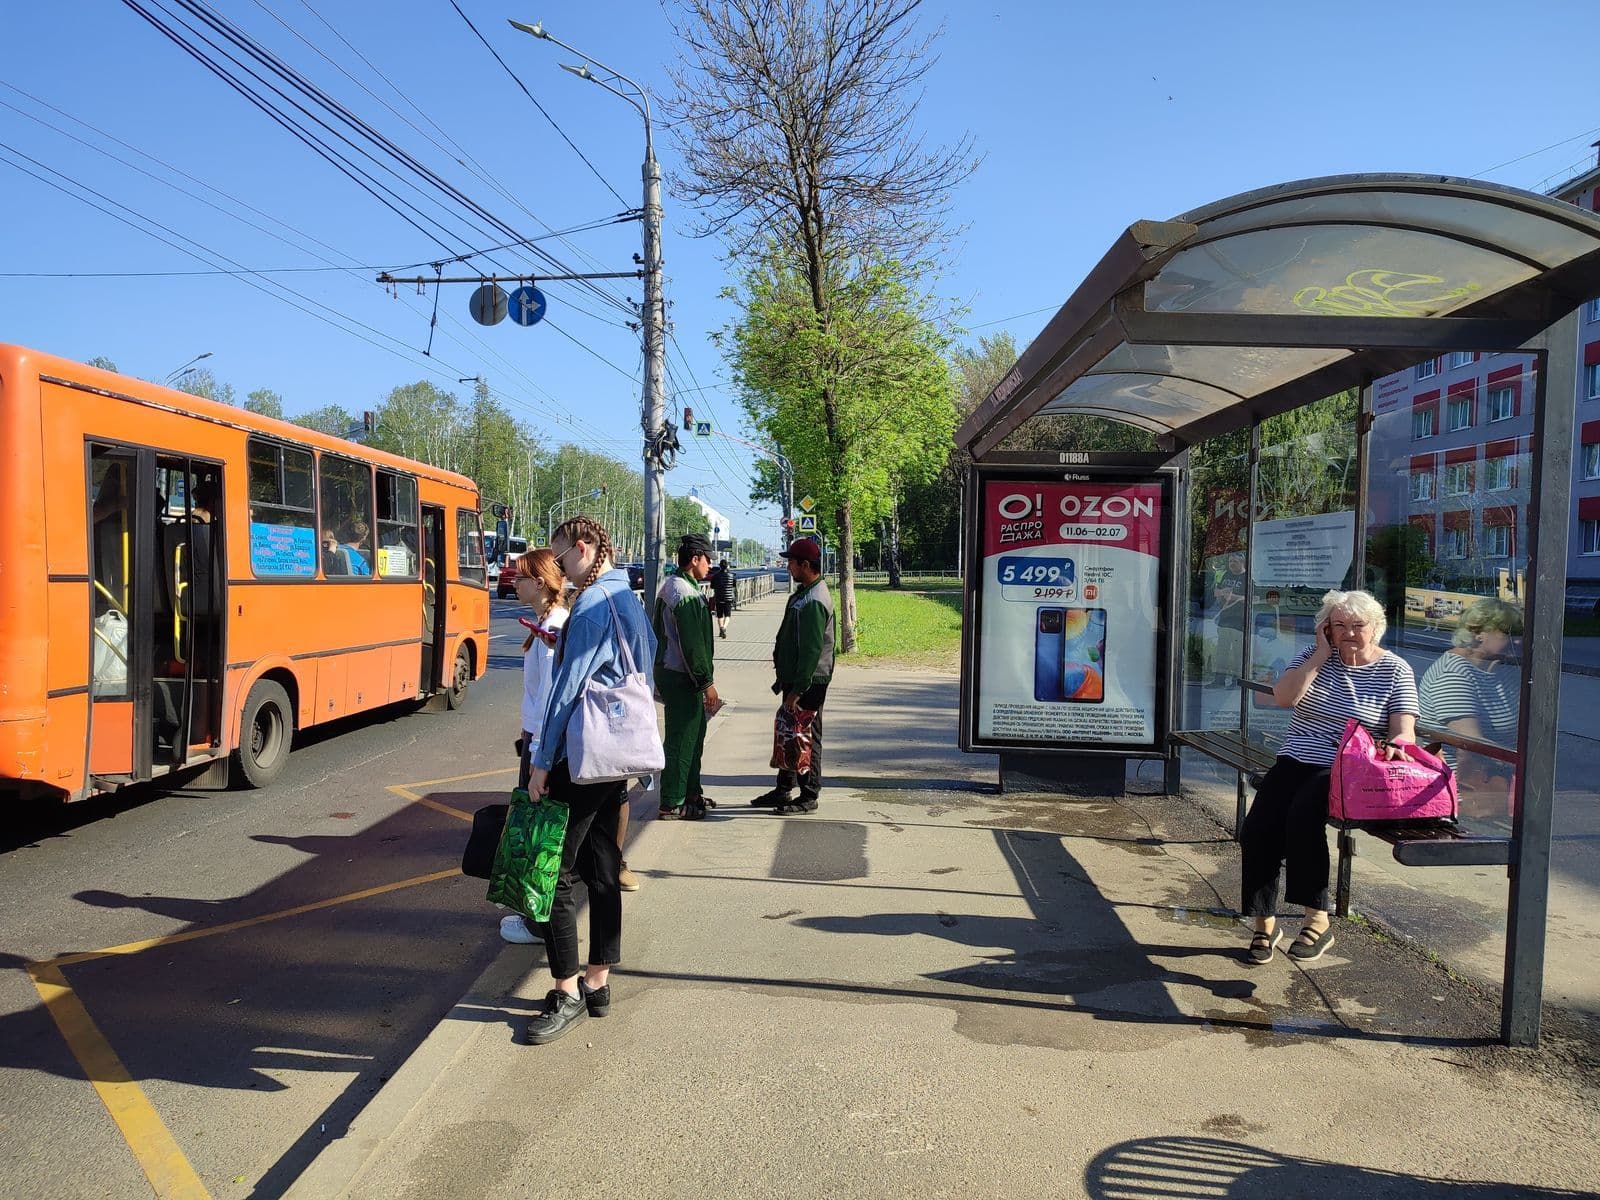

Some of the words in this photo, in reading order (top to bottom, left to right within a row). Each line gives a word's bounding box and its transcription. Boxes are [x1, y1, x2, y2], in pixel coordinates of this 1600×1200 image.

[1059, 452, 1090, 464] 01188A
[1072, 473, 1090, 481] Russ
[1059, 495, 1154, 518] OZON
[1000, 521, 1043, 533] РАСПРО
[999, 531, 1042, 543] ДАЖА
[1002, 565, 1016, 582] 5
[1020, 566, 1061, 583] 499
